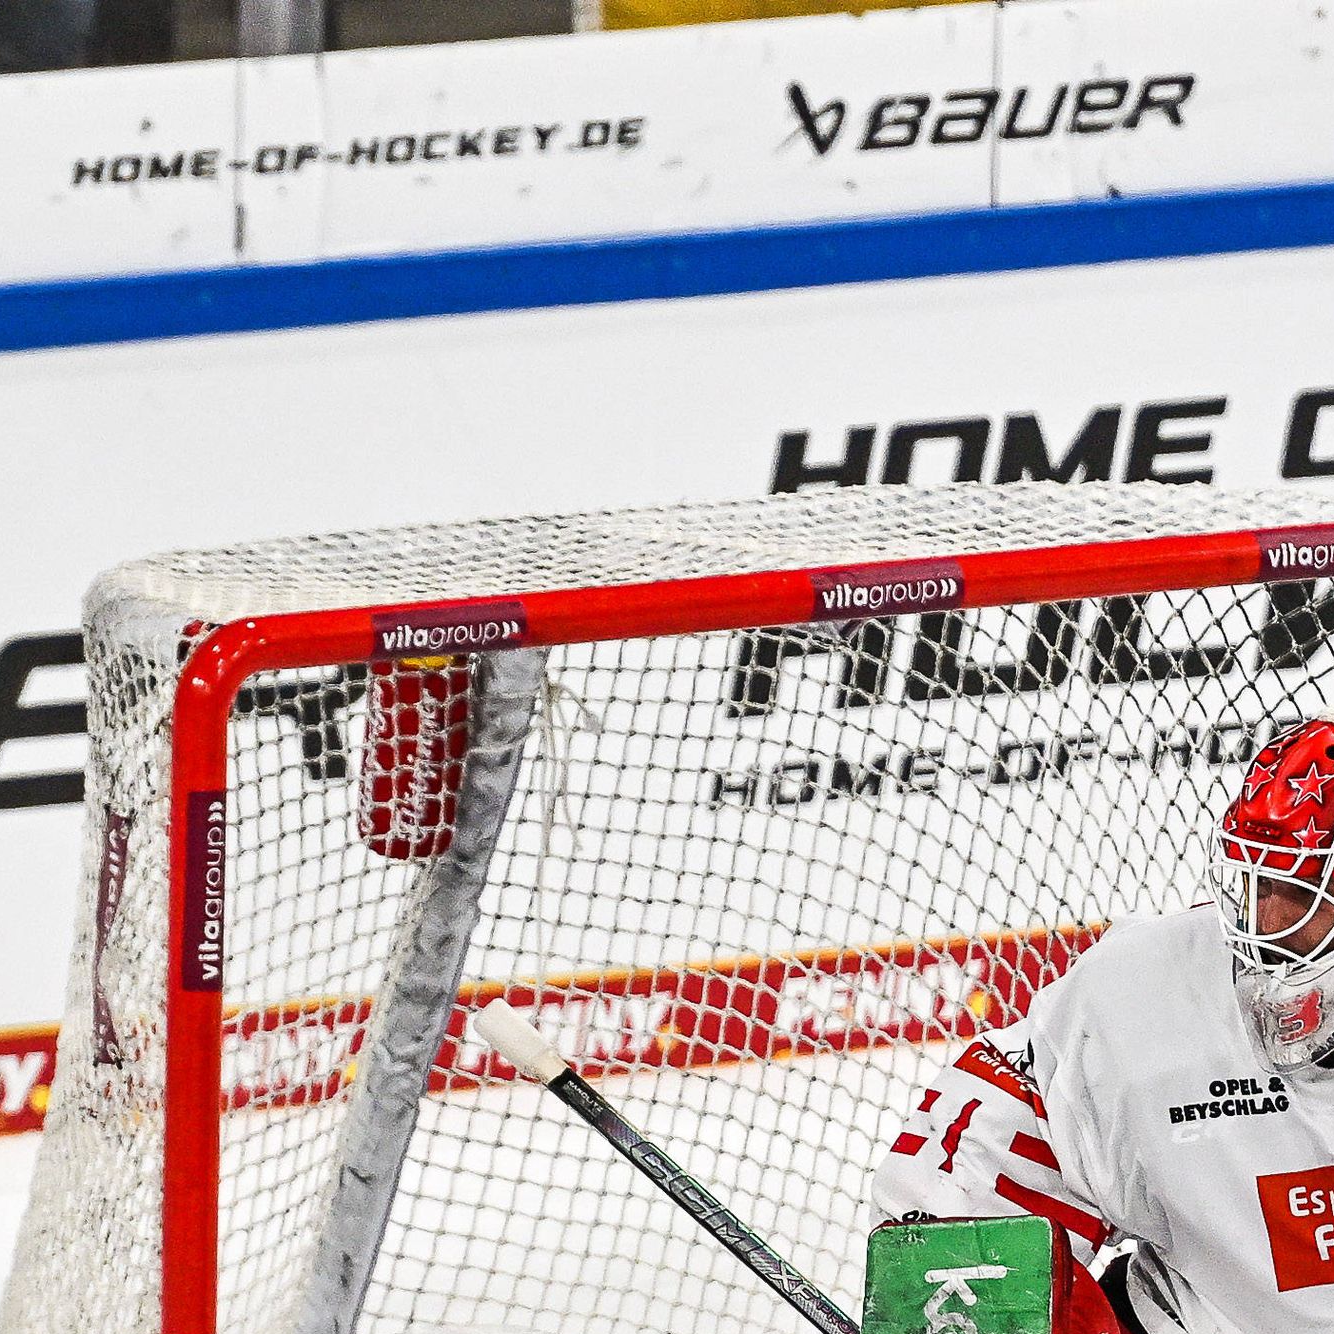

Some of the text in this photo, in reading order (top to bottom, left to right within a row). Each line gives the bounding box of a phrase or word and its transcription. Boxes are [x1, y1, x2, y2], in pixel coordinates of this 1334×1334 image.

[859, 74, 1197, 152] BAUER
[72, 116, 647, 186] HOME-OF-HOCKEY.DE
[770, 397, 1228, 497] HOME
[1169, 1095, 1290, 1124] BEYSCHLAG
[1208, 1075, 1285, 1099] OPEL &
